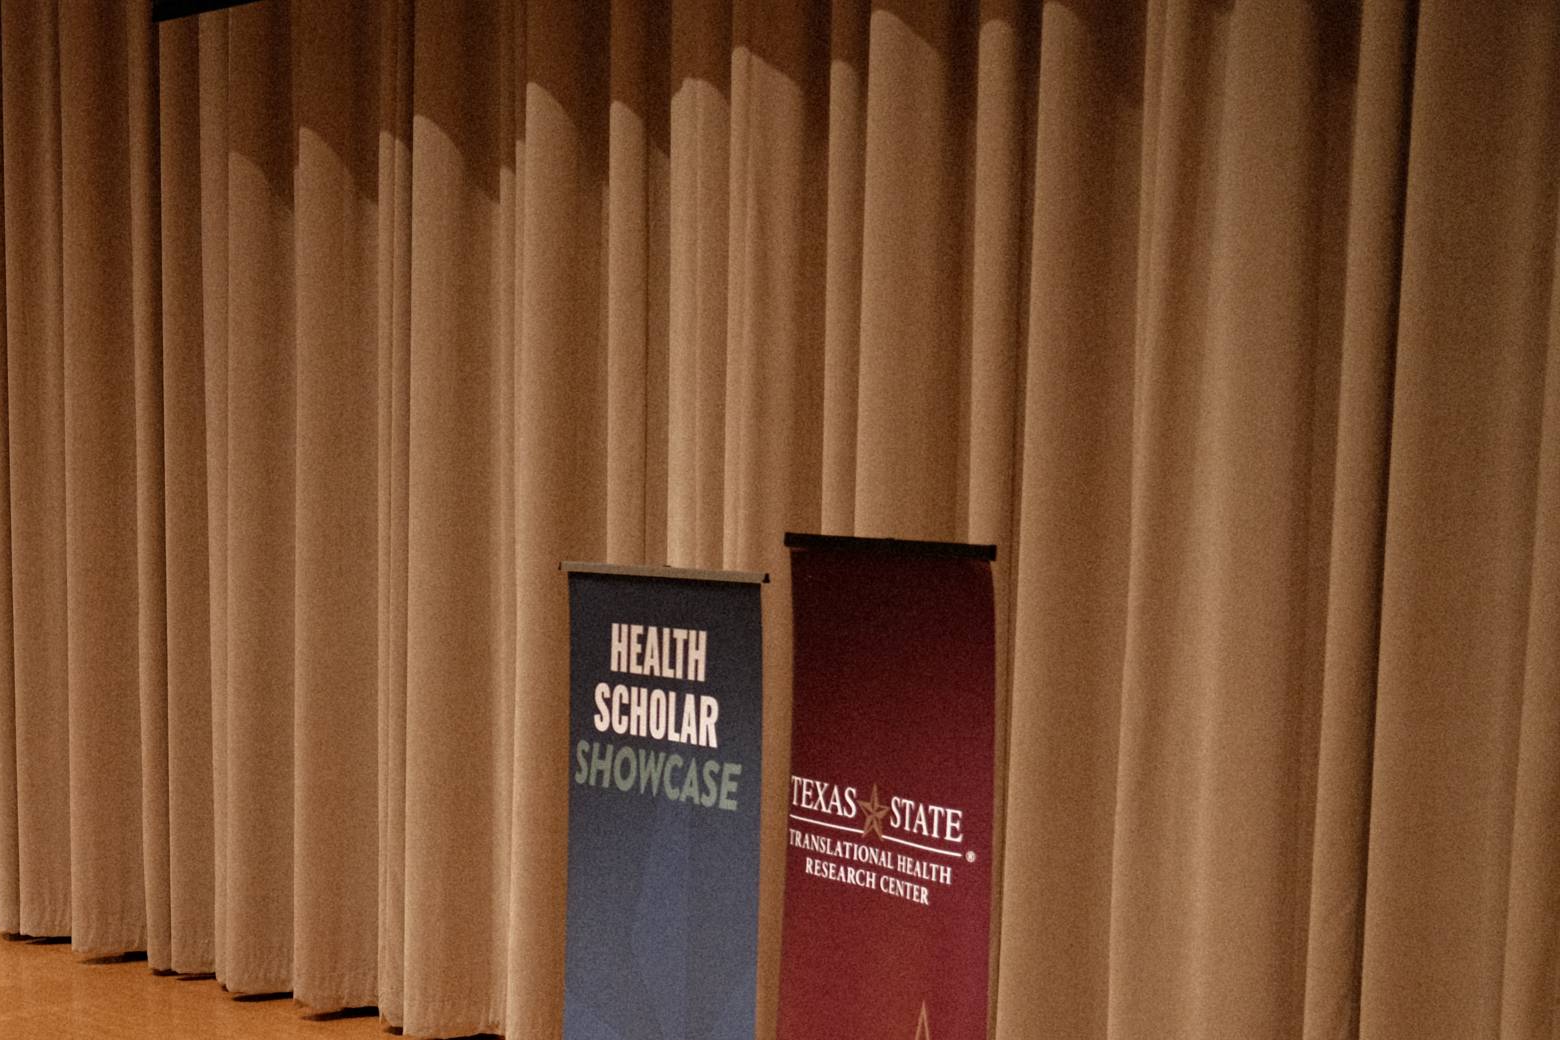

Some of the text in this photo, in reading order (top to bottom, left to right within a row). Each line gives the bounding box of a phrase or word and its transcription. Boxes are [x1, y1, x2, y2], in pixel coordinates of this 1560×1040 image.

[610, 622, 707, 682] HEALTH
[594, 682, 719, 748] SCHOLAR
[574, 738, 742, 811] SHOWCASE
[791, 775, 964, 843] TEXAS STATE
[789, 828, 953, 885] TRANSLATIONAL HEALTH
[805, 857, 930, 906] RESEARCH CENTER
